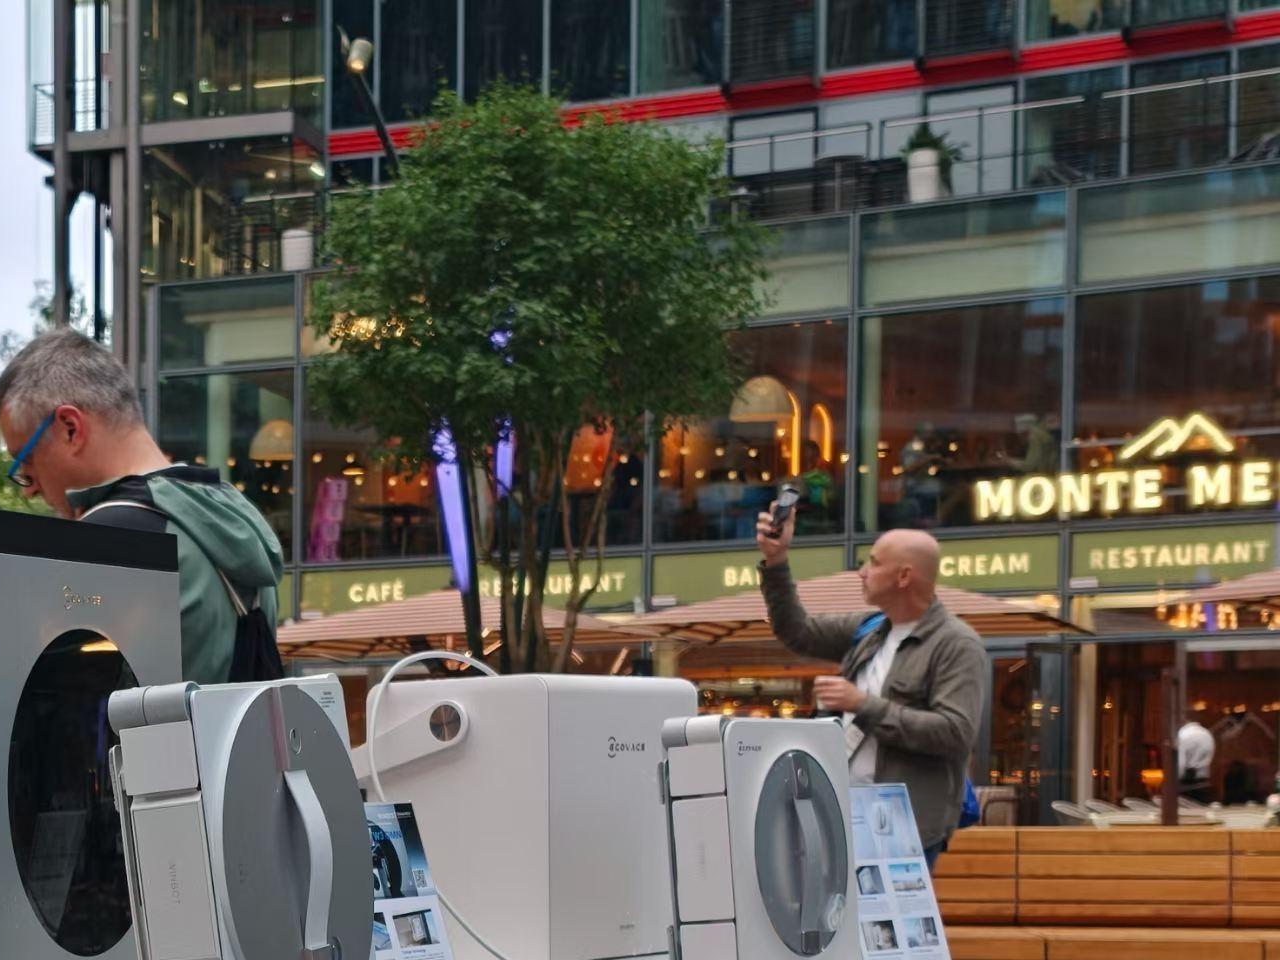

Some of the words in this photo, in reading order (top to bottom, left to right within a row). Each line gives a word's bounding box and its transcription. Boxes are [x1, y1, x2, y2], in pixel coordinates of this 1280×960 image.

[976, 469, 1162, 518] MONTE
[1191, 462, 1273, 505] ME
[938, 553, 1030, 577] CREAM
[1089, 541, 1268, 570] RESTAURANT
[349, 579, 405, 603] CAFÉ
